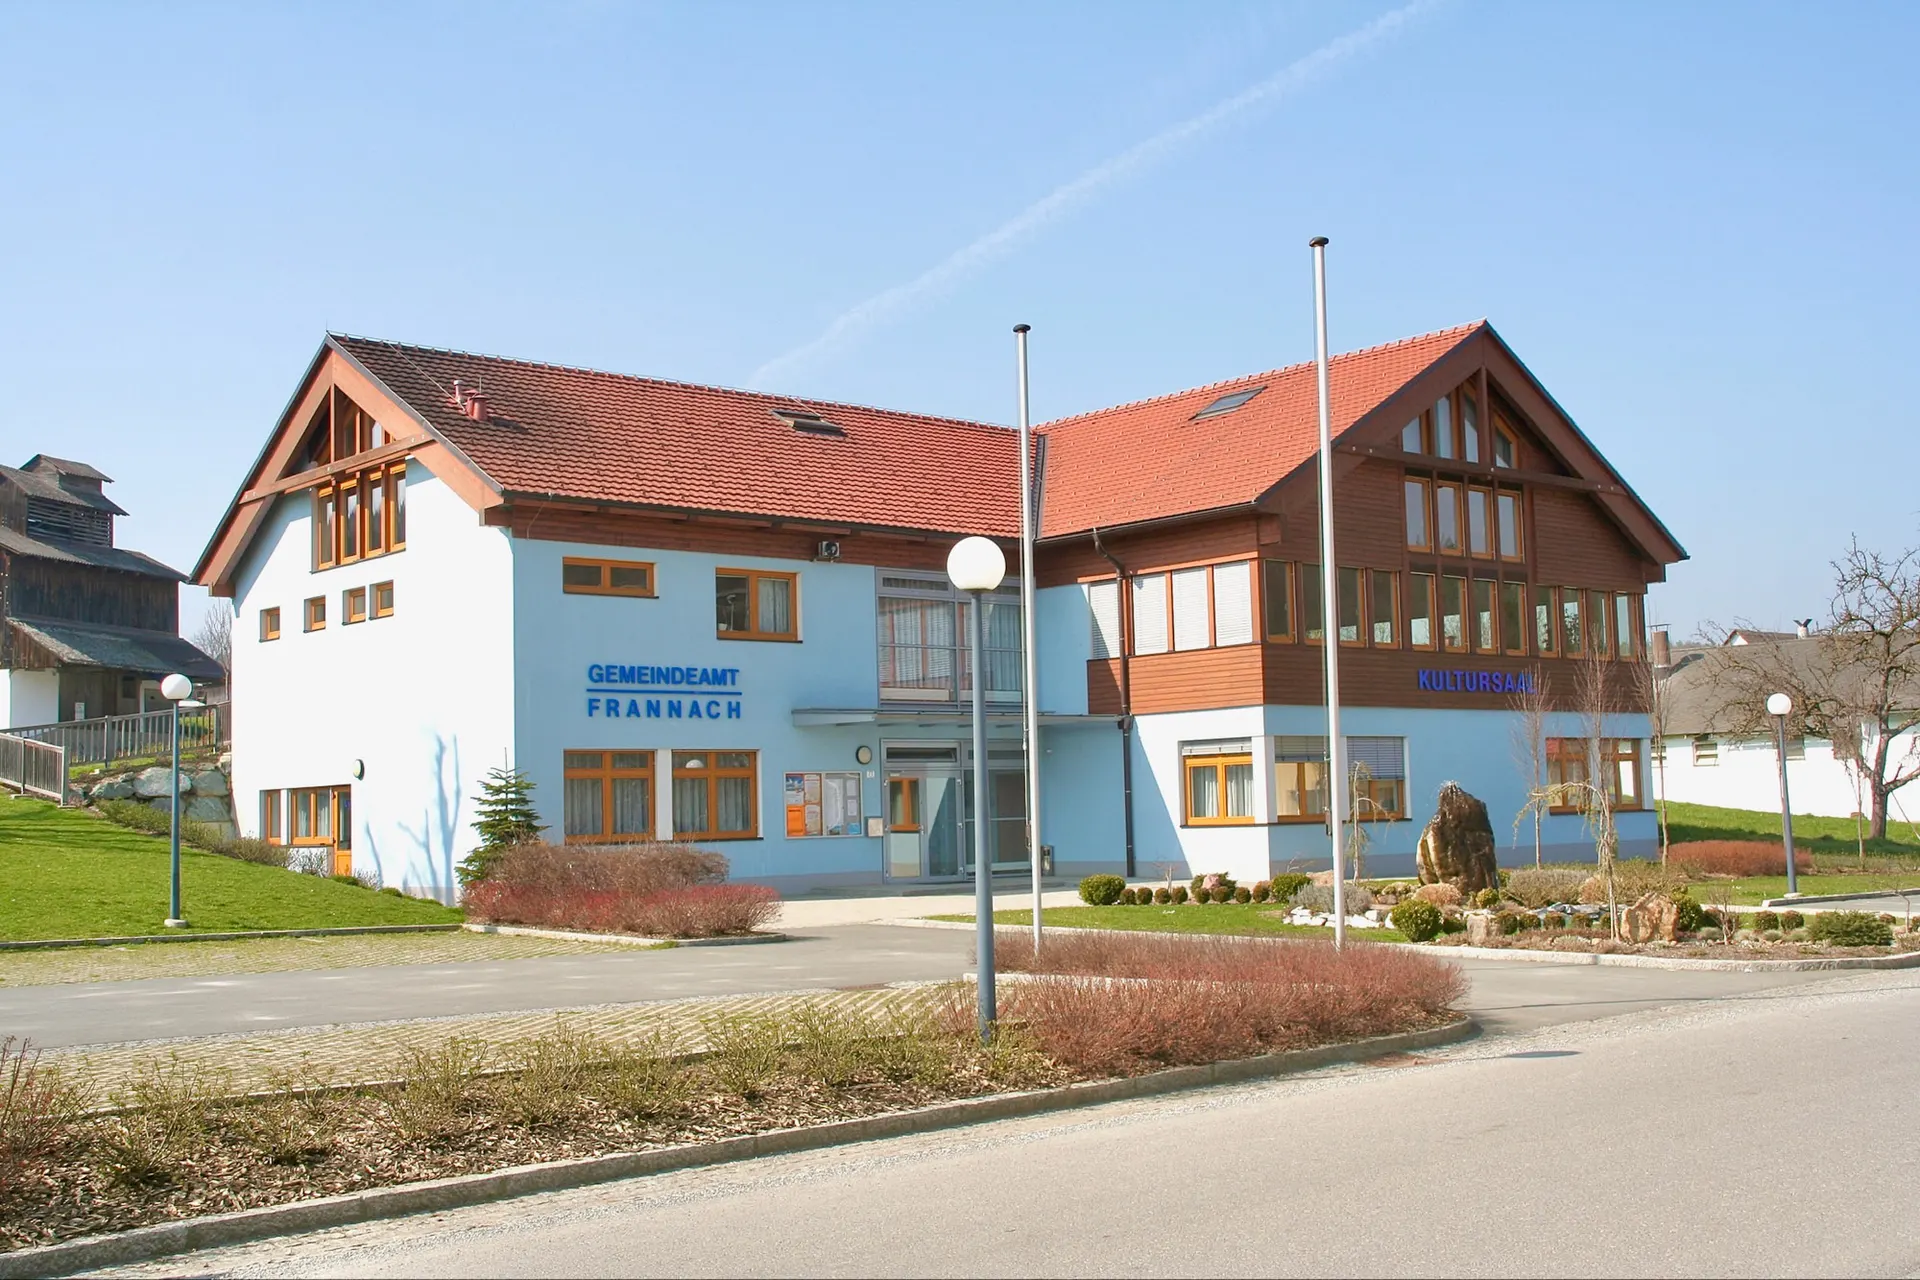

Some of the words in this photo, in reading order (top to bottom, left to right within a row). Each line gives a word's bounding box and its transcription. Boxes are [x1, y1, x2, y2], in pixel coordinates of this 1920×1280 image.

[588, 664, 740, 686] GEMEINDEAMT
[1418, 669, 1537, 694] KULTURSAAL
[588, 698, 741, 719] FRANNACH
